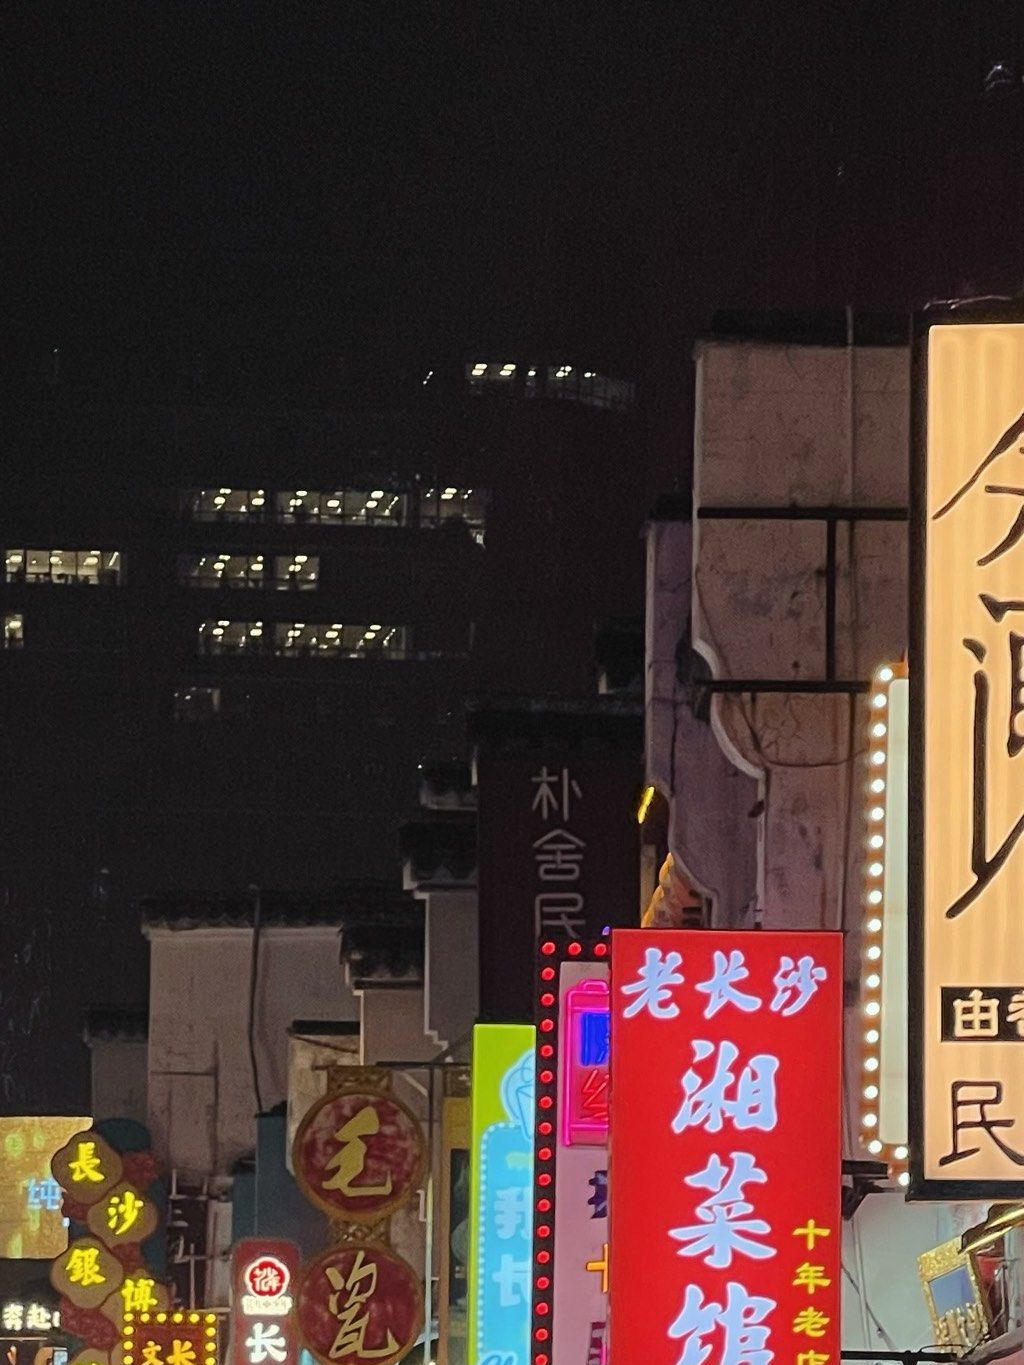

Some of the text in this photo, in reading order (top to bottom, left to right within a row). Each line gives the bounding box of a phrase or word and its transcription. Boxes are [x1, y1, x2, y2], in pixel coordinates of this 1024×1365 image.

[621, 947, 828, 1019] 老长沙
[3, 1304, 60, 1330] 奔赴
